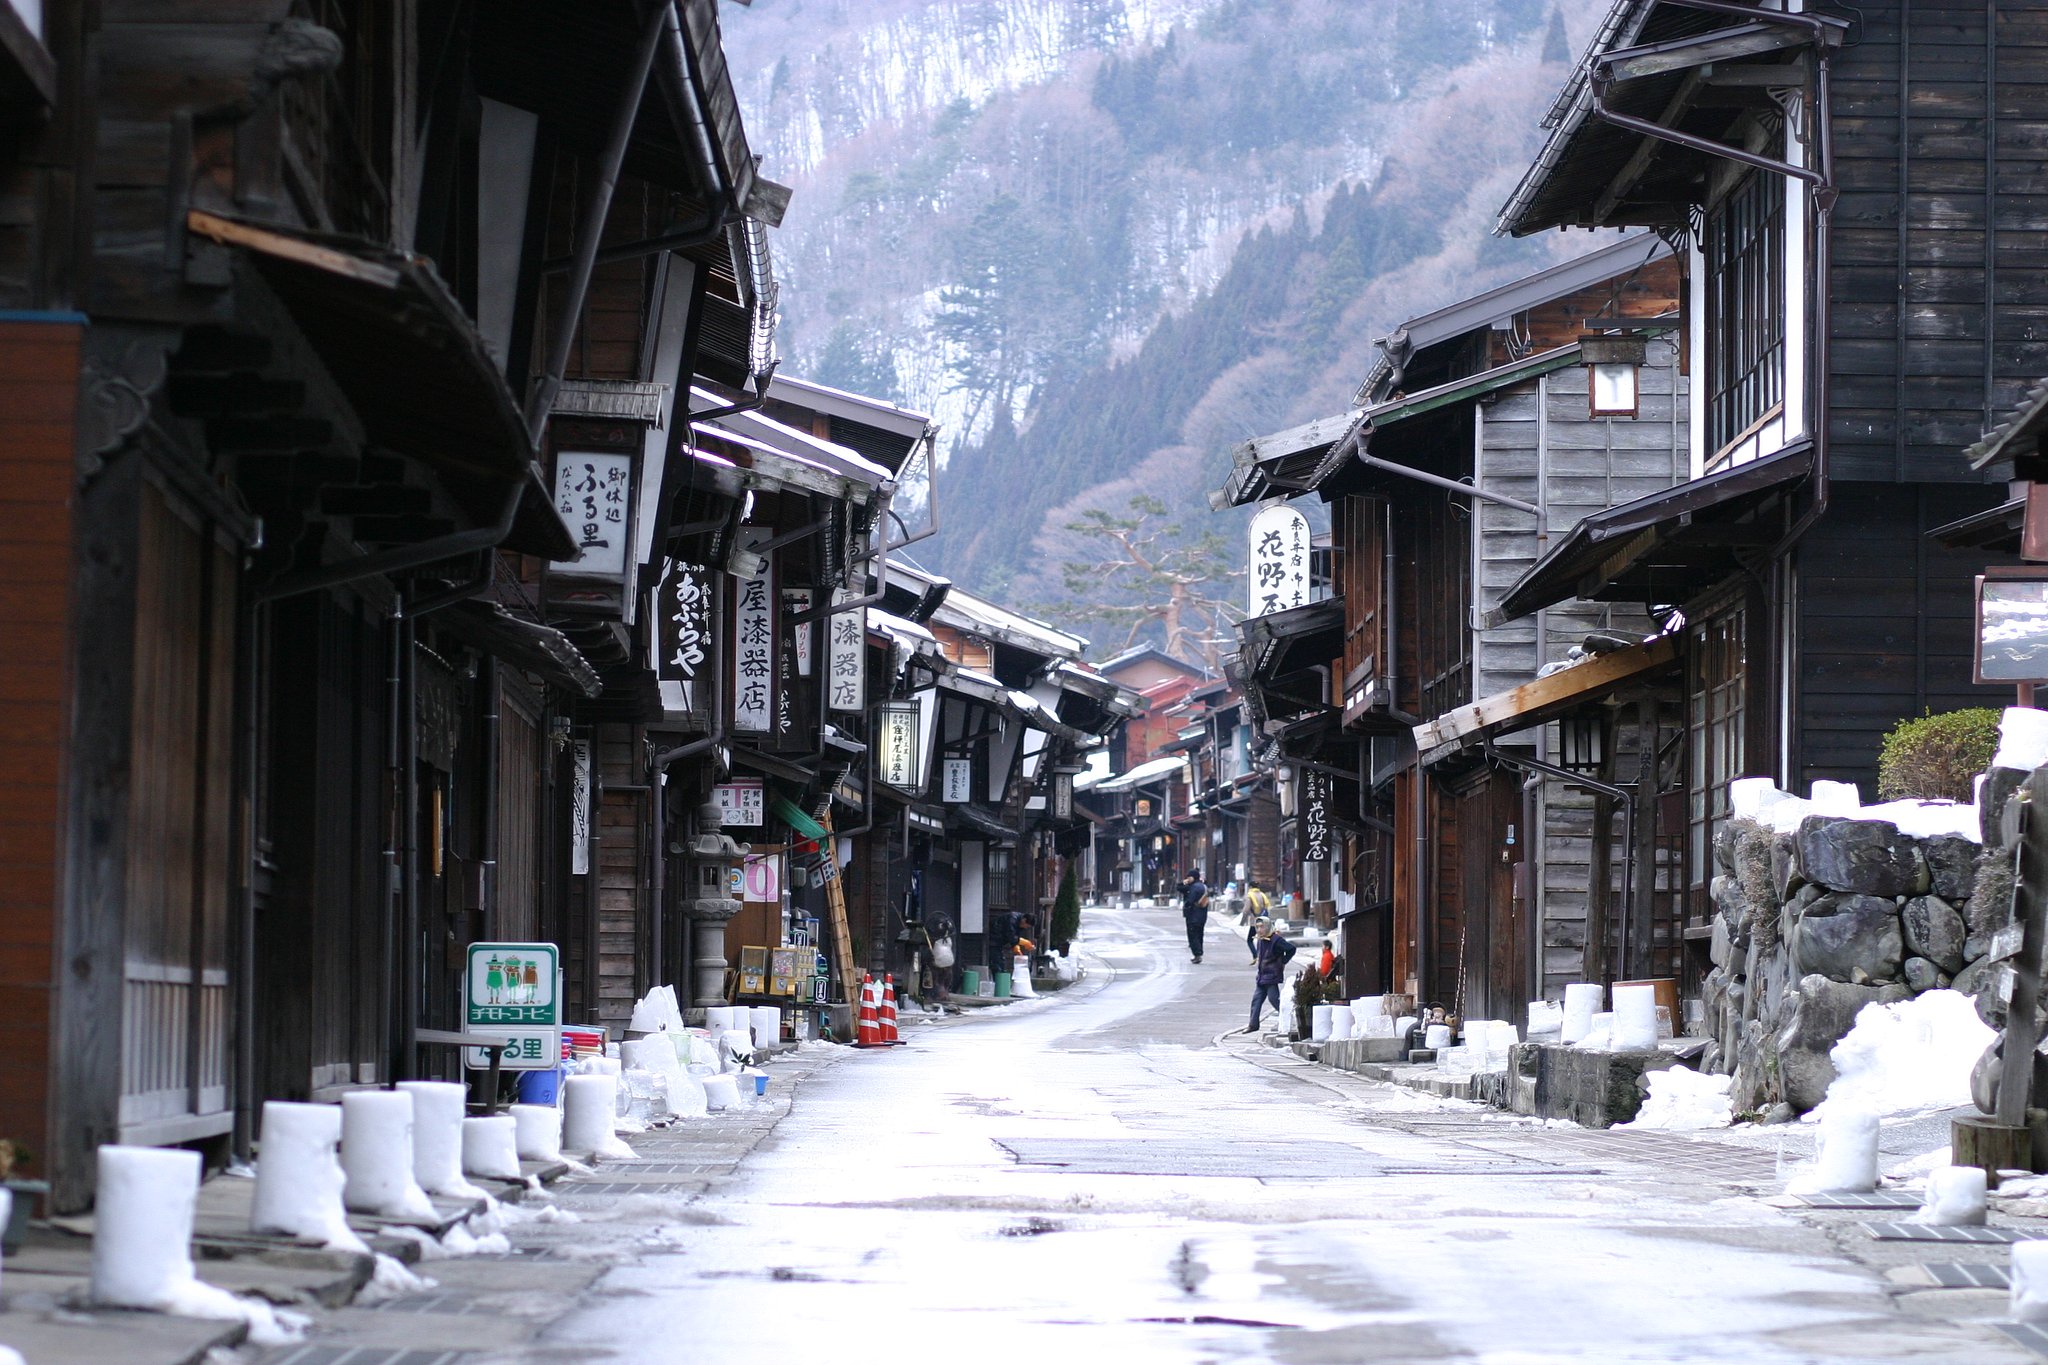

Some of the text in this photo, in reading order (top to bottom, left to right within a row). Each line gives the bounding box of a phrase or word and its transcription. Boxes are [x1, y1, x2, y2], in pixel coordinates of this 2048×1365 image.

[574, 463, 609, 548] ふる里
[605, 466, 627, 523] 御休処
[1290, 516, 1305, 567] 奈良井宿
[1257, 529, 1287, 615] 花野屋
[669, 572, 705, 677] あぶらや
[1305, 800, 1328, 860] 花野屋
[471, 1007, 552, 1020] チモトコーヒー
